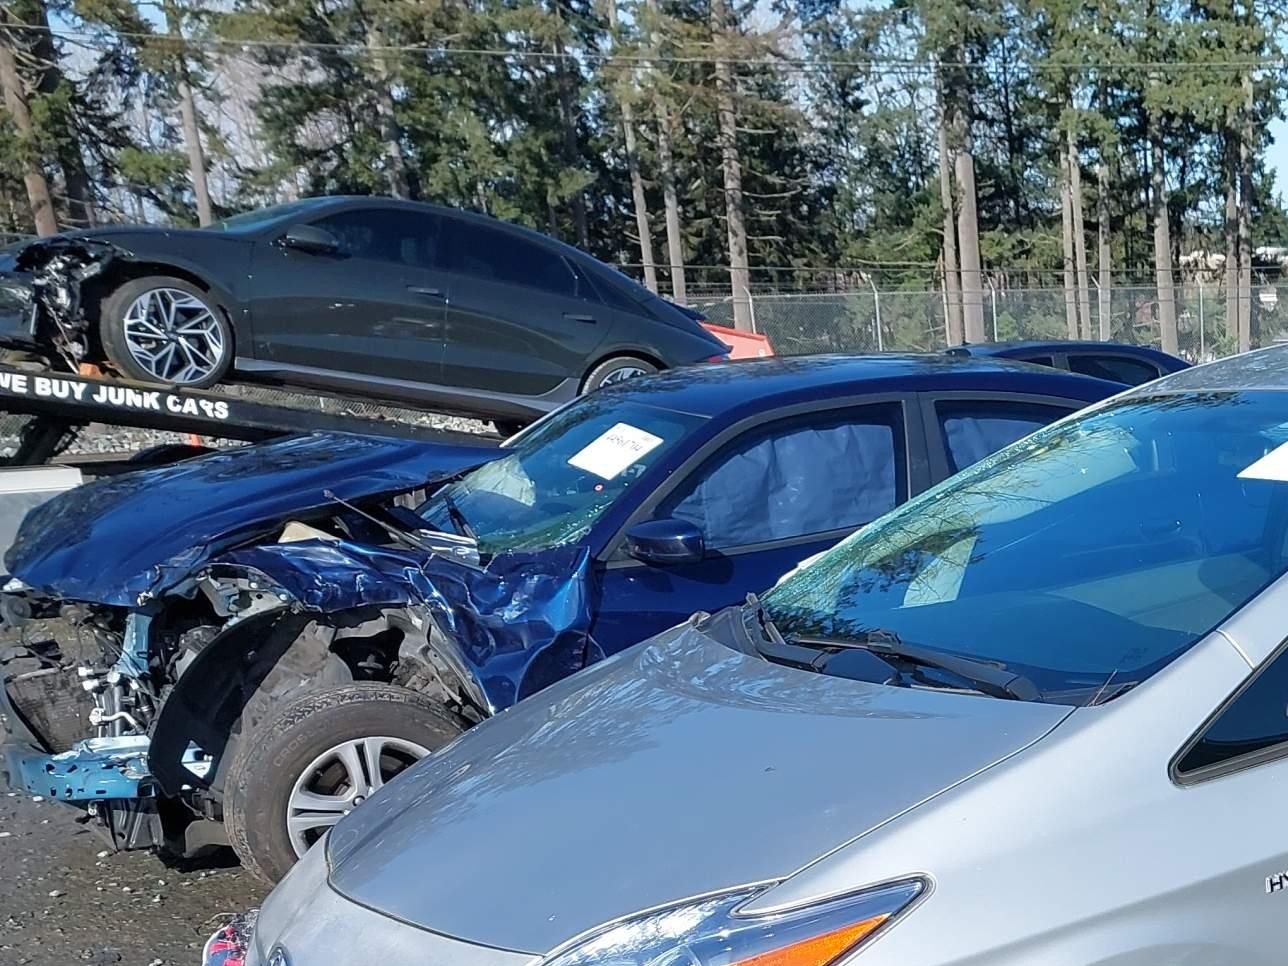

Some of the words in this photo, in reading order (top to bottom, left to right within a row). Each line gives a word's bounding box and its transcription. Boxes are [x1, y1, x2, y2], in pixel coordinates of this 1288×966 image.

[35, 377, 88, 400] BUY
[92, 385, 161, 410] JUNK
[166, 394, 229, 419] CARS
